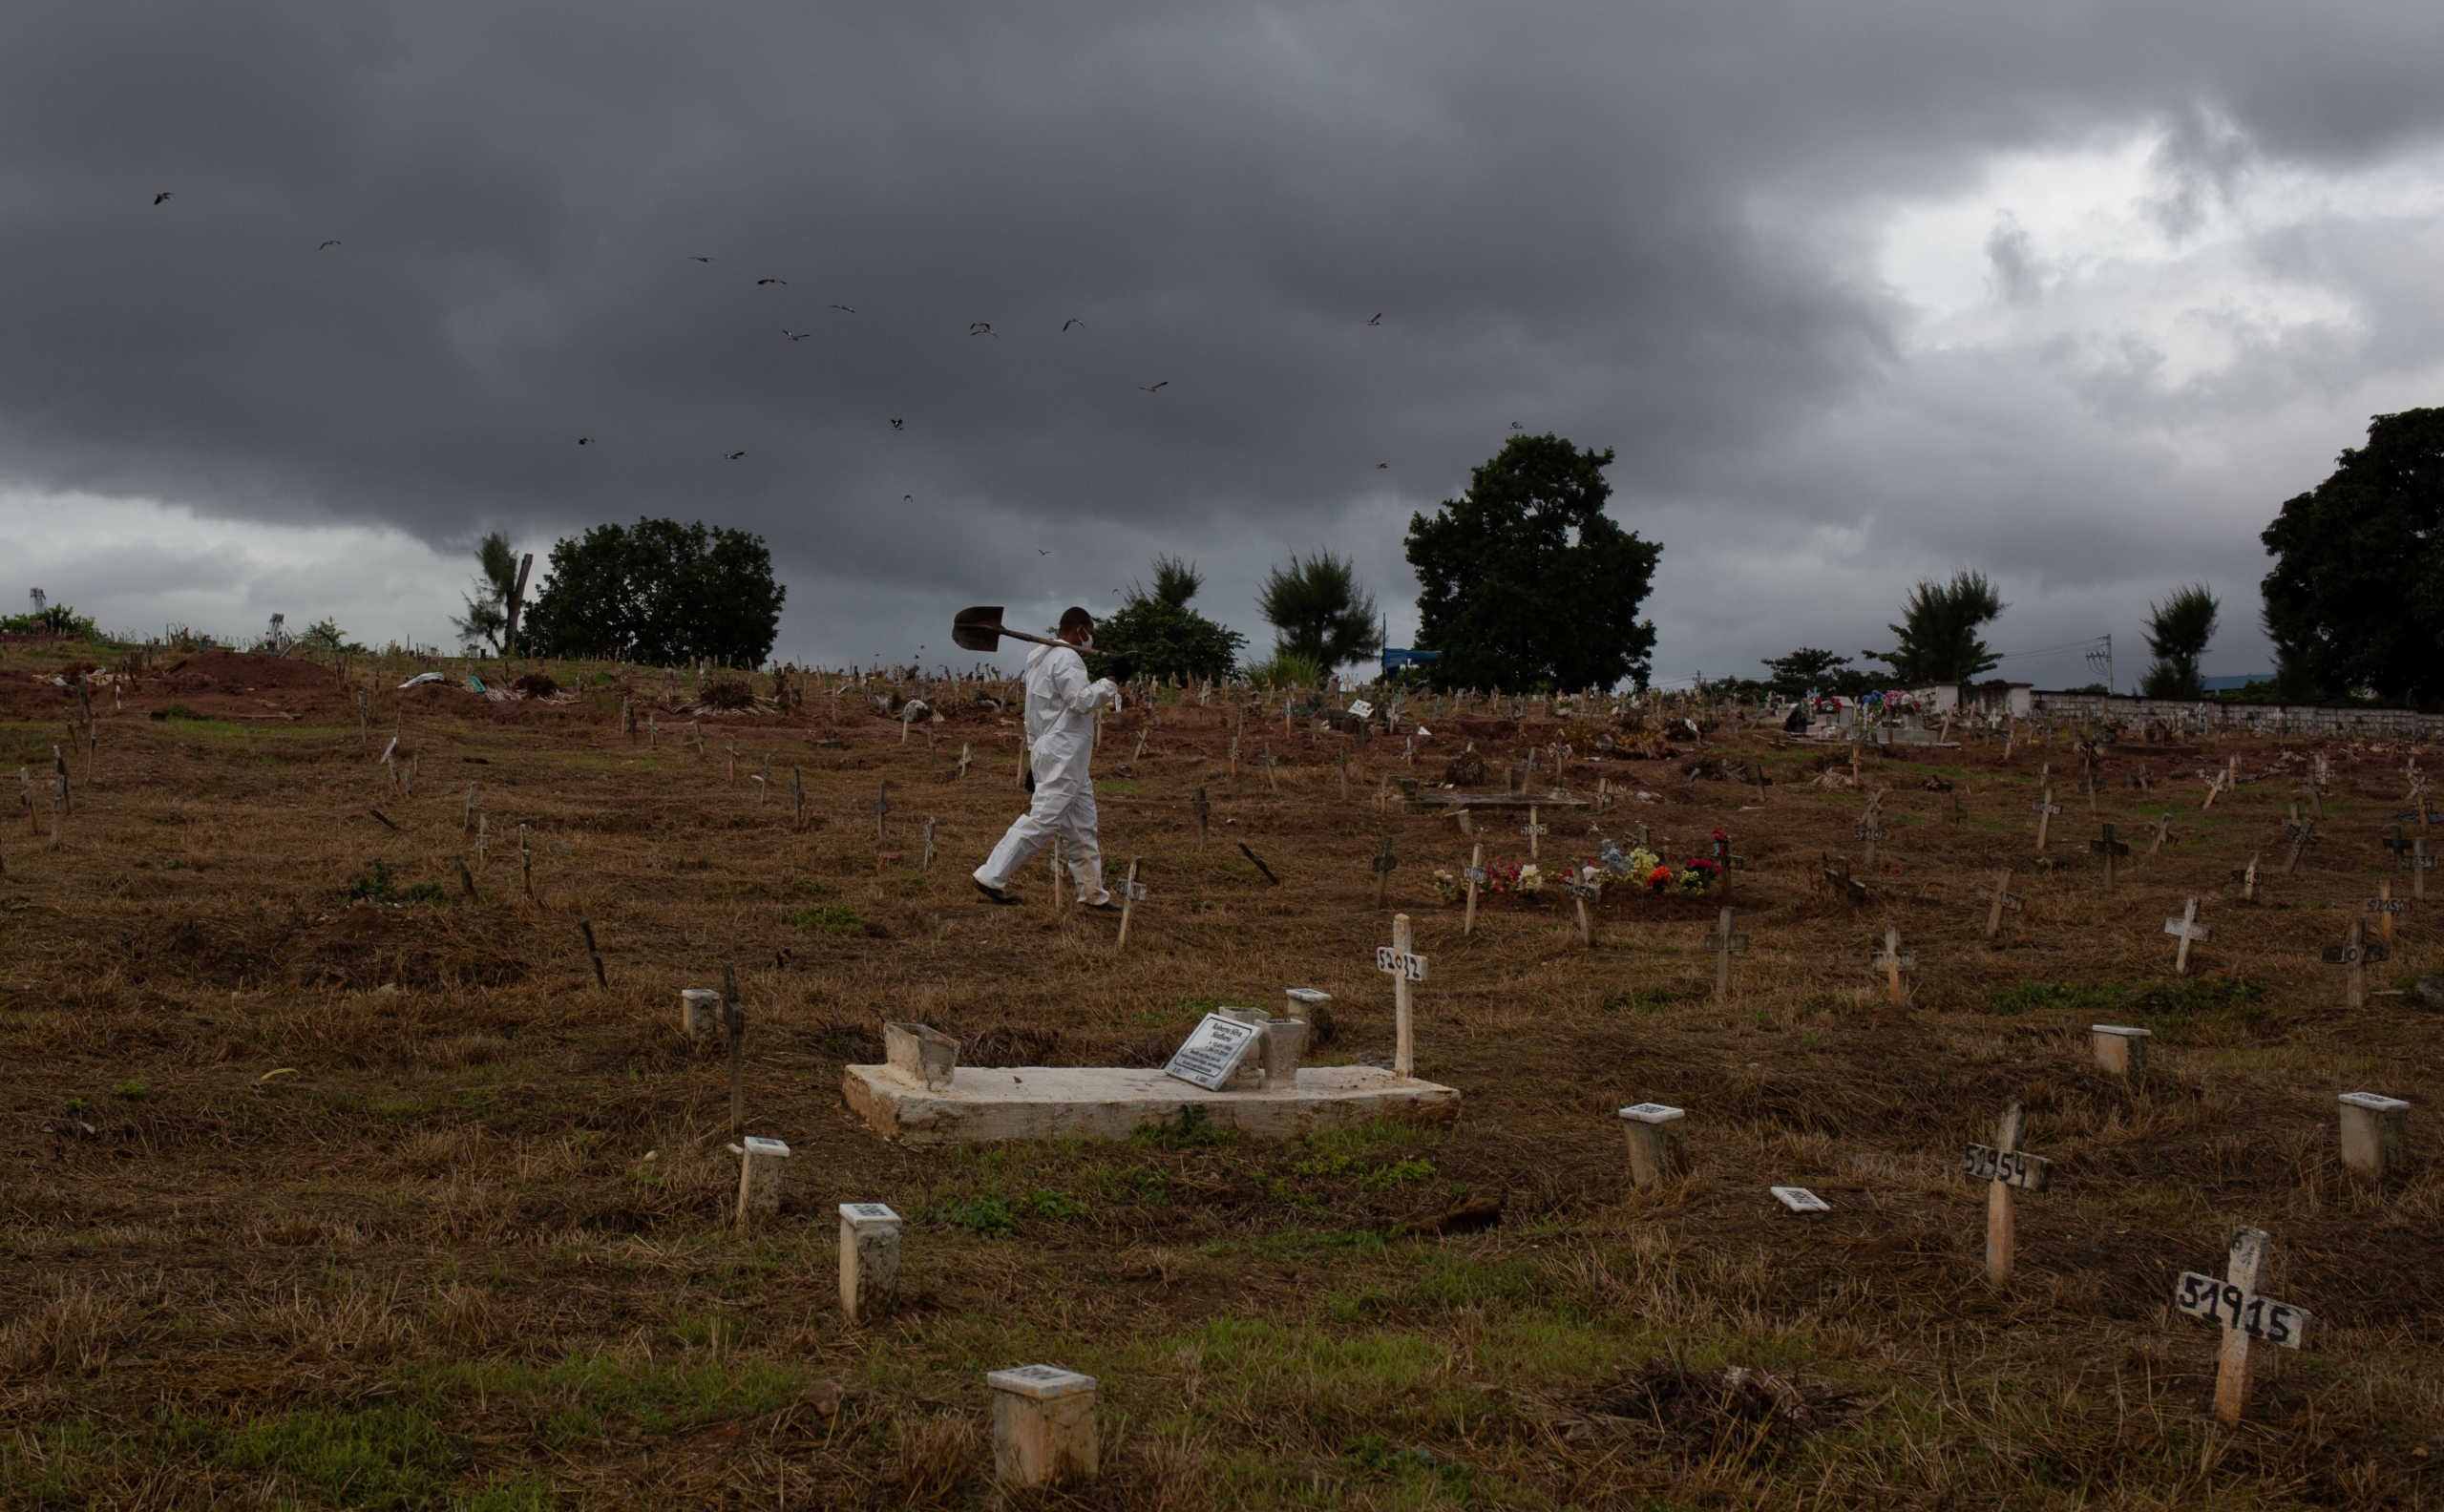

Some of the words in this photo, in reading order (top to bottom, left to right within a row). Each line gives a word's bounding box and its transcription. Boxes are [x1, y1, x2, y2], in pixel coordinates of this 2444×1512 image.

[1380, 949, 1421, 979] 52032
[1965, 1144, 2026, 1187] 51954
[2179, 1276, 2291, 1342] 51915
